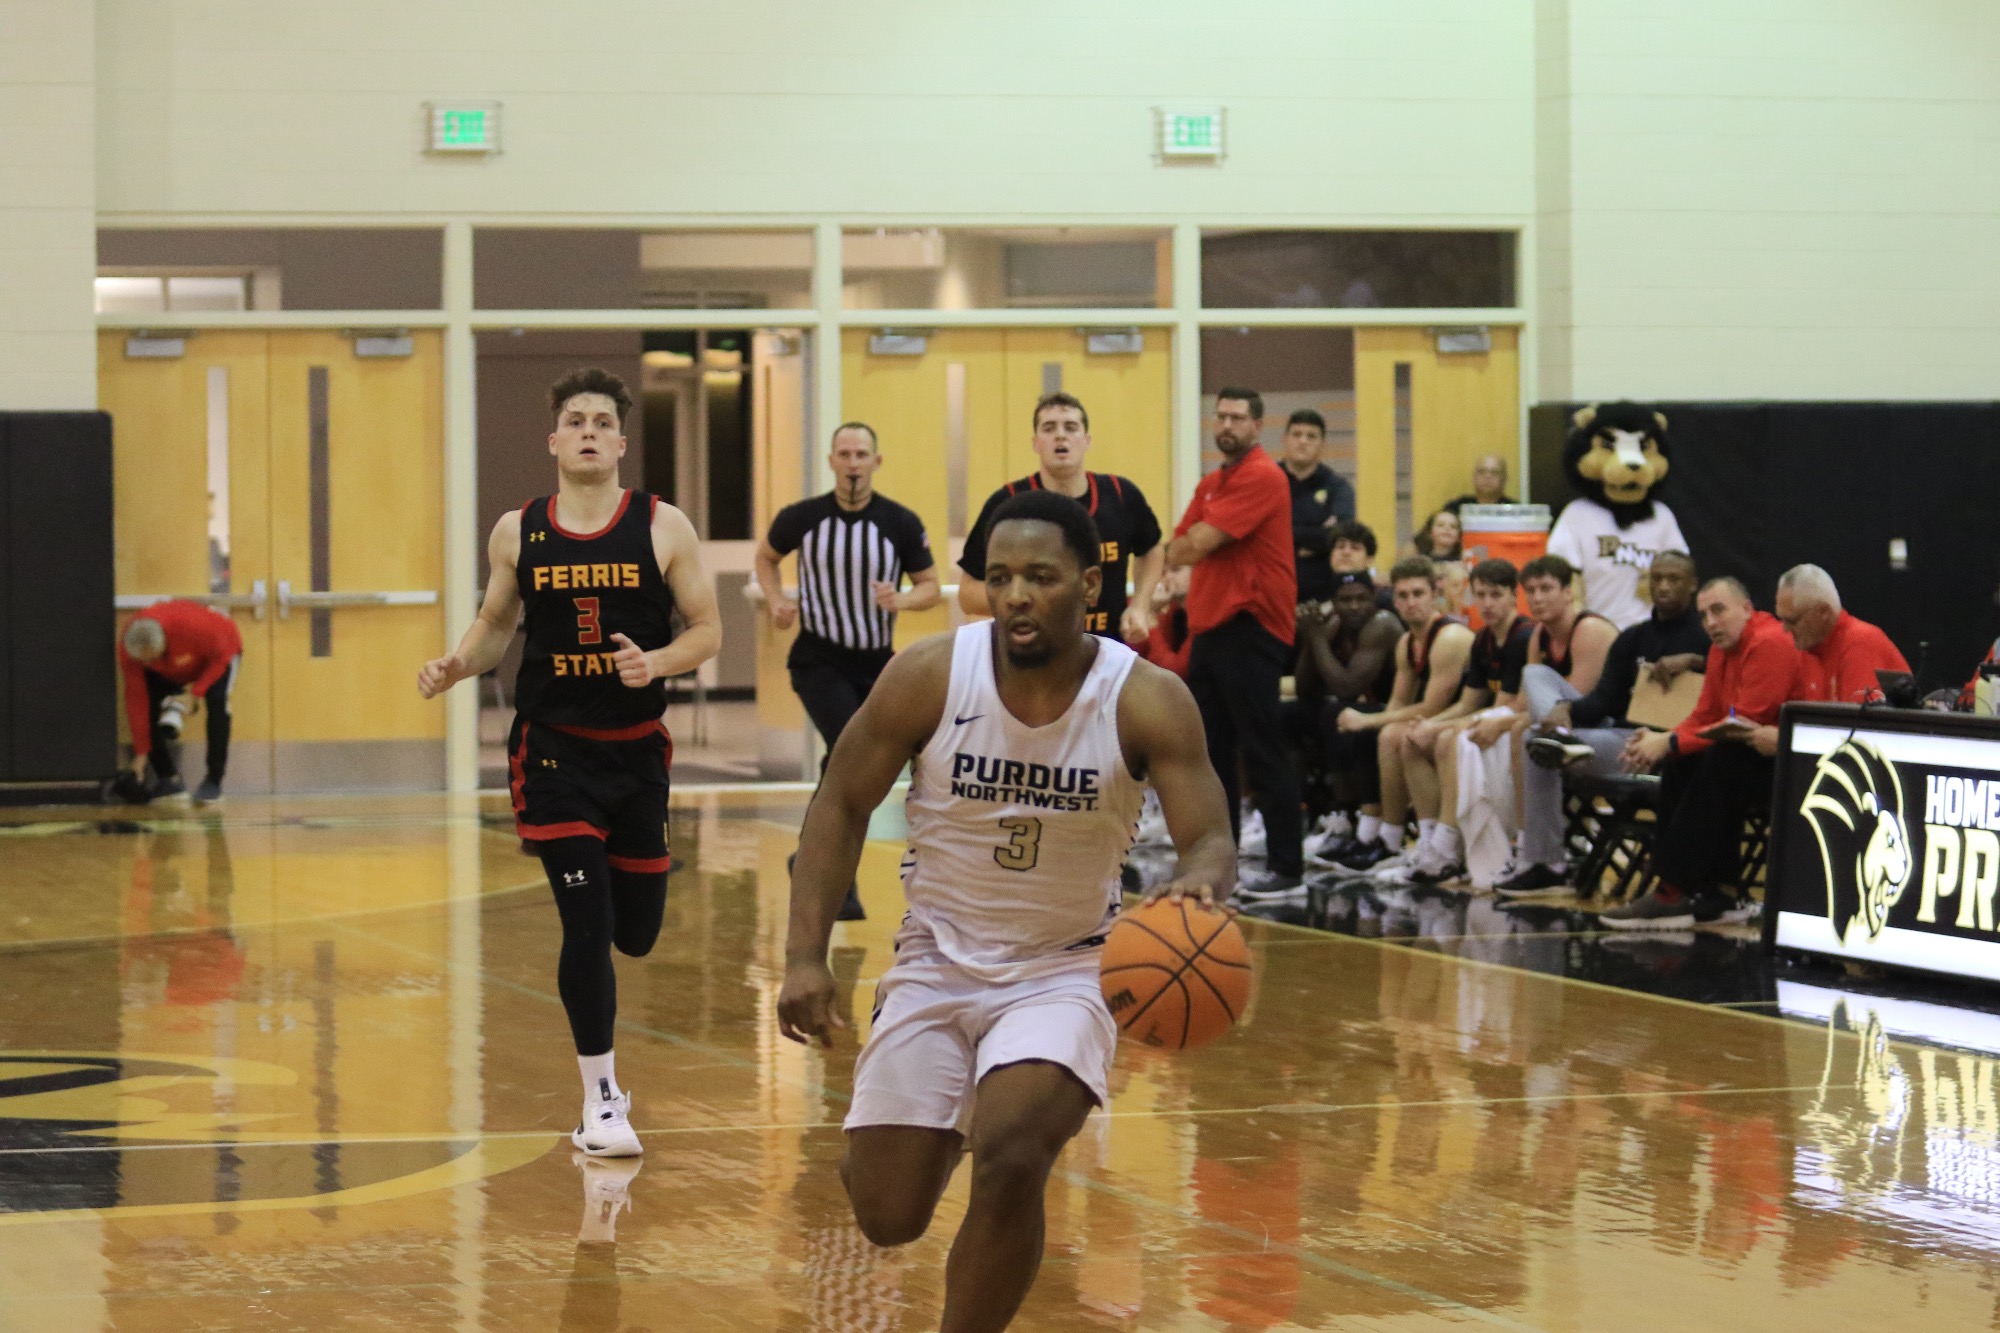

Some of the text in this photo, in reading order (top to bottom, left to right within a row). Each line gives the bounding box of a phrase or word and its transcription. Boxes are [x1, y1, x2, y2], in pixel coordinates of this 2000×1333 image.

[533, 563, 640, 591] FERRIS
[573, 597, 602, 645] 3
[552, 652, 616, 677] STAT
[952, 752, 1099, 795] PURDUE
[1924, 774, 2000, 831] HOME
[993, 815, 1042, 871] 3
[1916, 823, 2000, 932] PR
